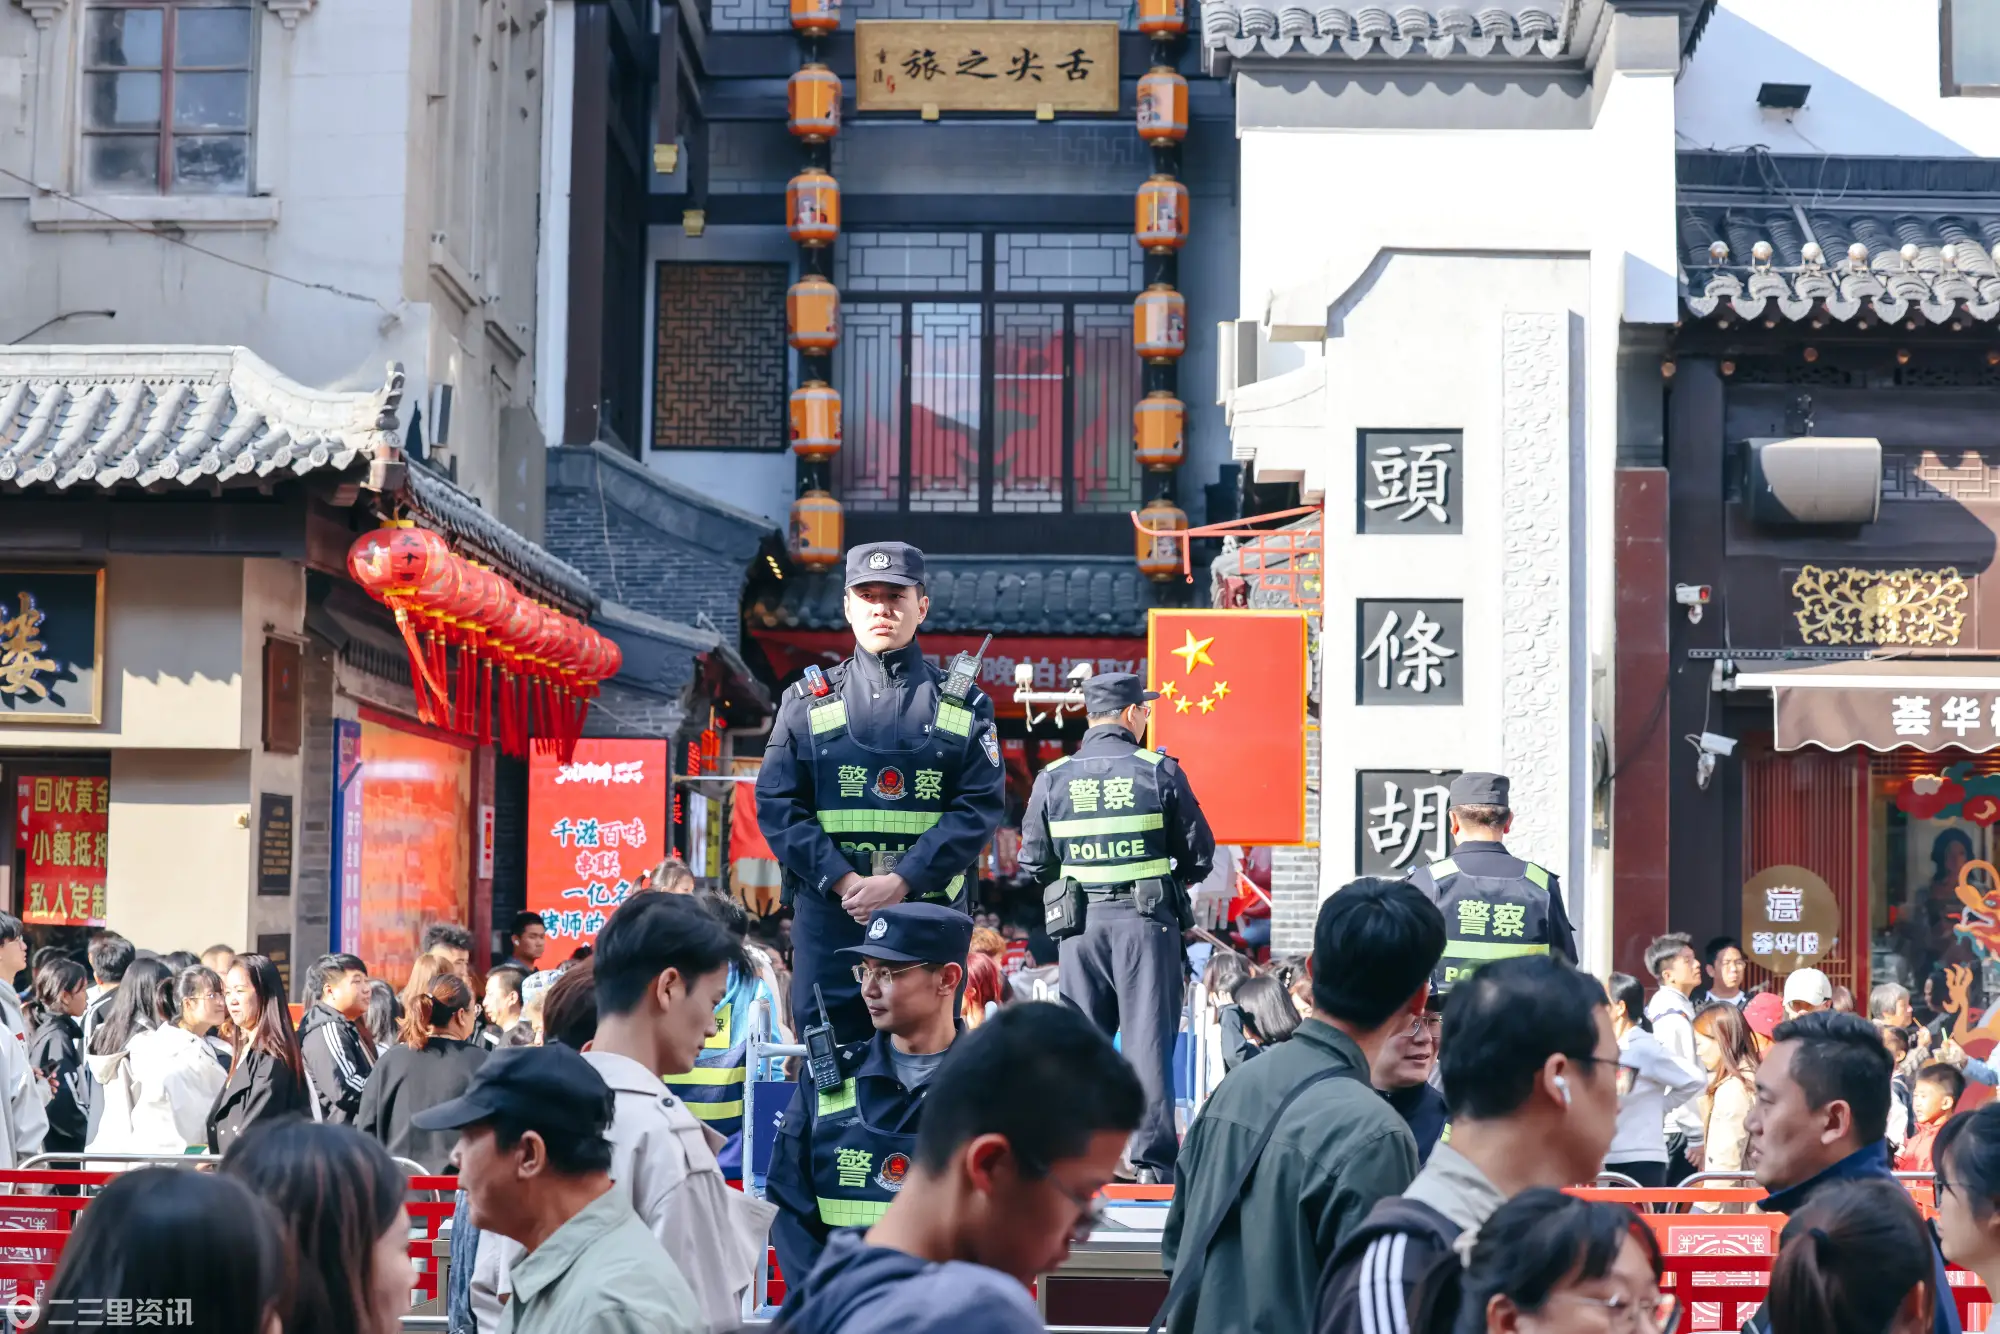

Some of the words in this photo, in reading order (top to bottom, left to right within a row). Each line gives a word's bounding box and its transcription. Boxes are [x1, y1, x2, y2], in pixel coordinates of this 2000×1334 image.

[1892, 695, 2000, 737] 荟华
[34, 777, 108, 814] 回收黄金
[838, 765, 868, 798] 警
[914, 768, 943, 800] 察
[1068, 776, 1135, 813] 警察
[31, 829, 107, 868] 小额抵押
[551, 817, 647, 848] 千滋百味
[1069, 839, 1145, 860] POLICE
[575, 850, 621, 880] 串联
[29, 881, 107, 920] 私人定制
[562, 879, 631, 907] 一亿名
[1458, 899, 1525, 937] 警察
[836, 1148, 873, 1188] 警
